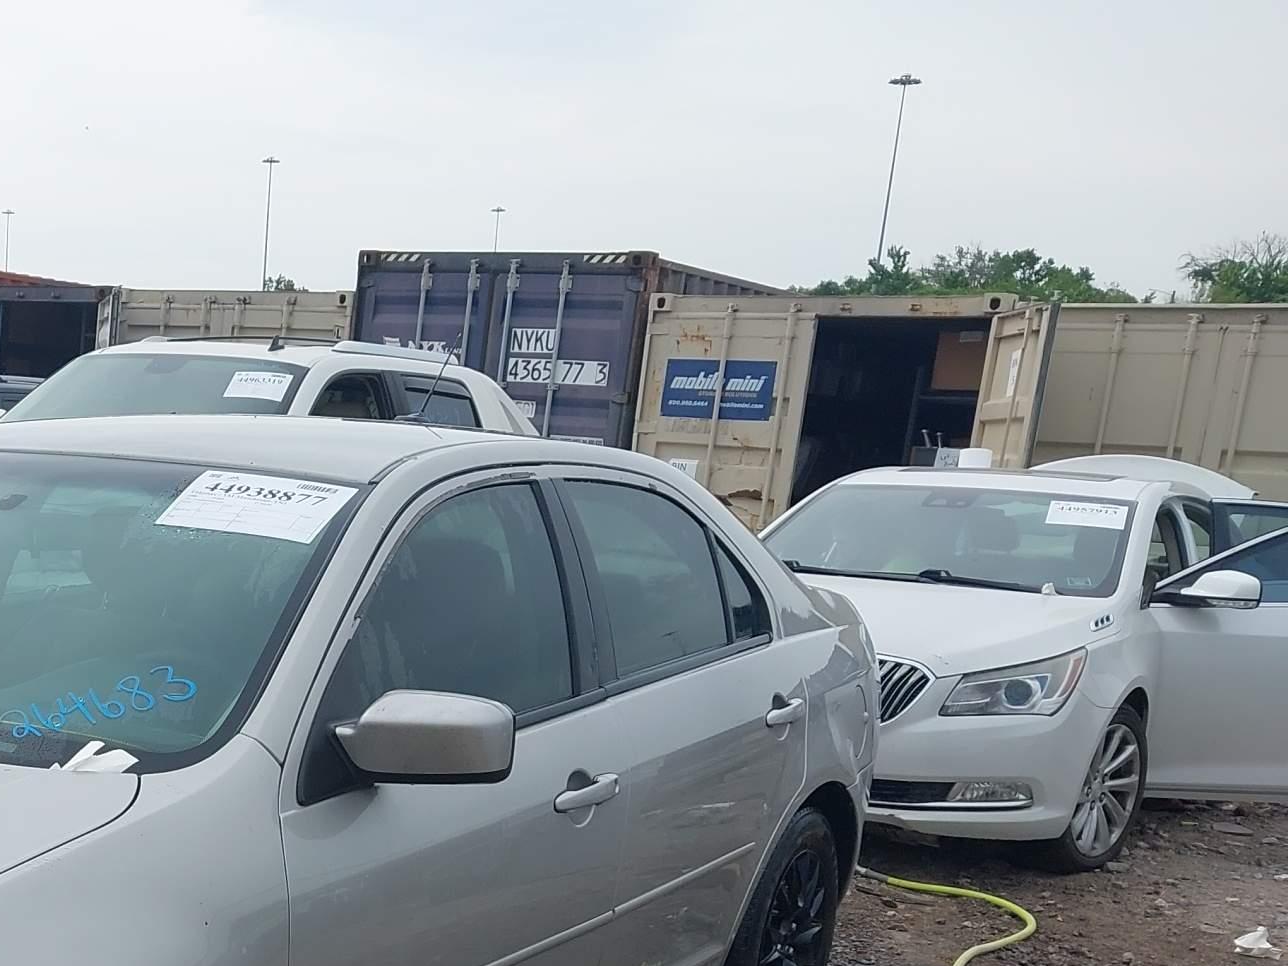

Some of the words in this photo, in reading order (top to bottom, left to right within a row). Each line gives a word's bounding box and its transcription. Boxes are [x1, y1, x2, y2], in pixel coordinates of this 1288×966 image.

[511, 329, 555, 352] NYKU
[595, 363, 608, 384] 3
[725, 375, 766, 392] mini
[204, 481, 329, 507] 44938877
[0, 665, 198, 738] 264683
